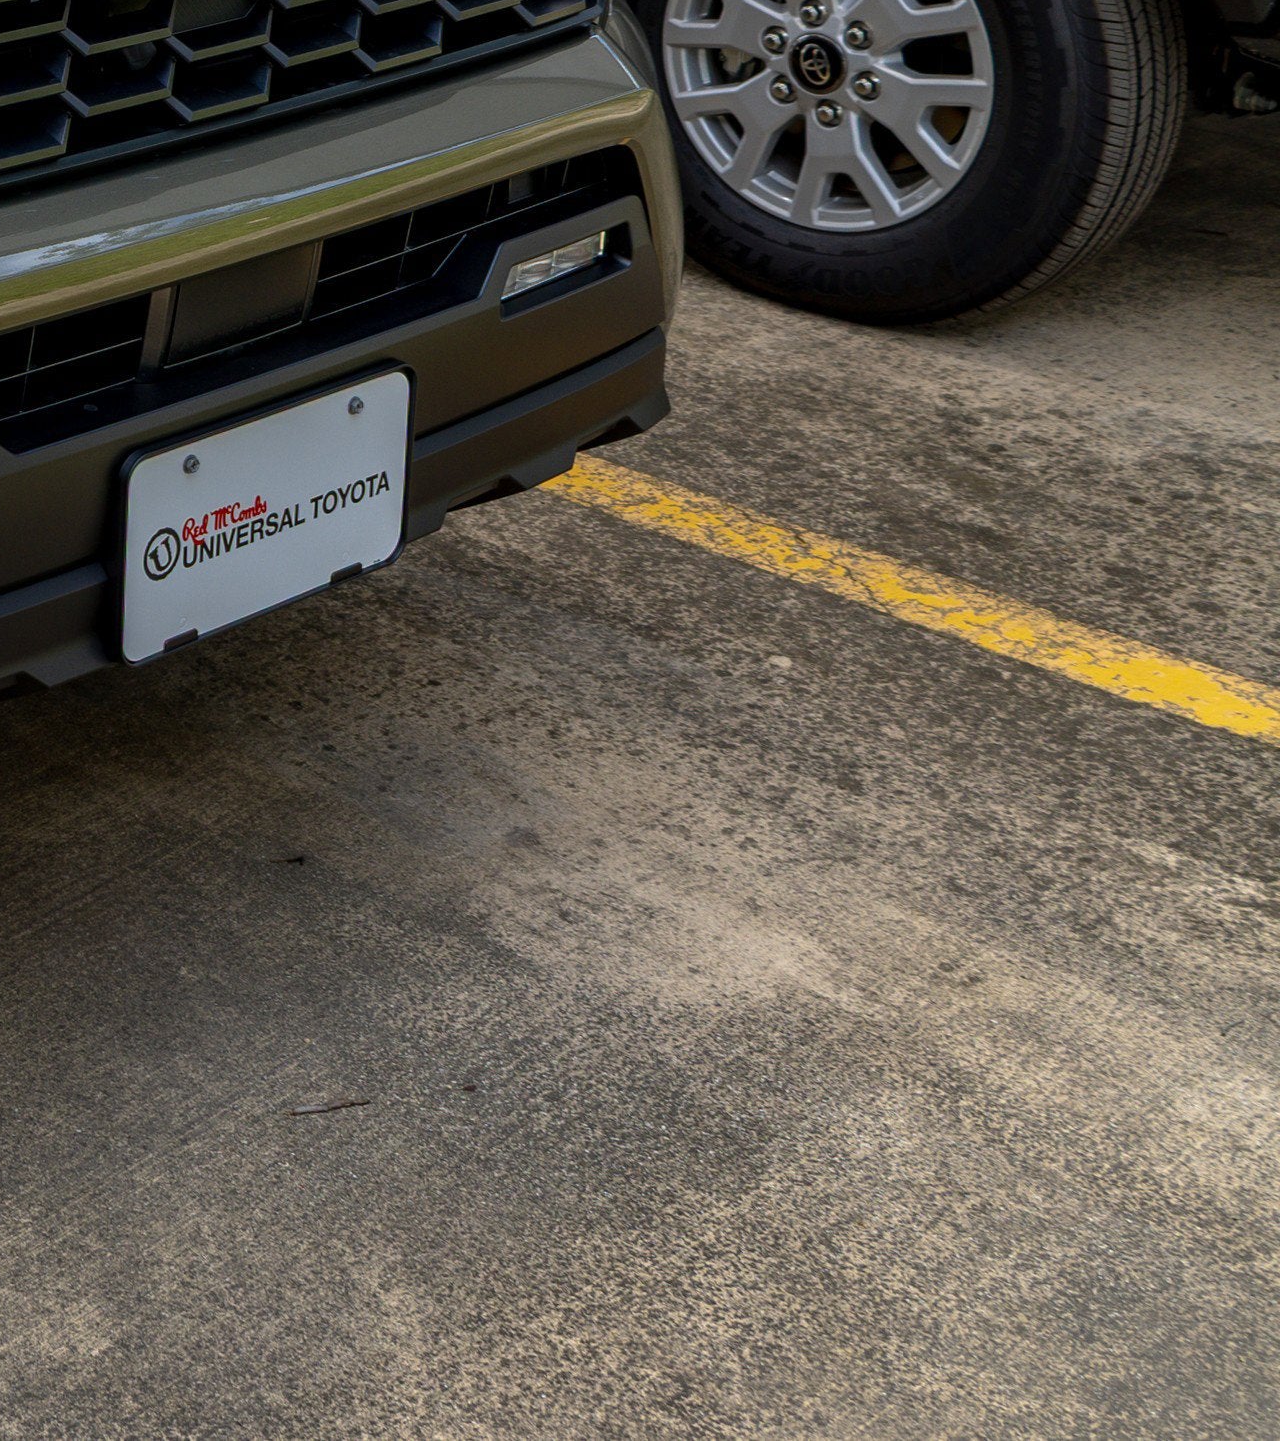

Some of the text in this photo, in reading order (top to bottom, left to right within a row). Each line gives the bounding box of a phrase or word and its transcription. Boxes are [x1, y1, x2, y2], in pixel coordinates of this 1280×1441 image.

[182, 470, 391, 569] UNIVERSAL TOYOTA
[182, 495, 268, 546] Red McCombs
